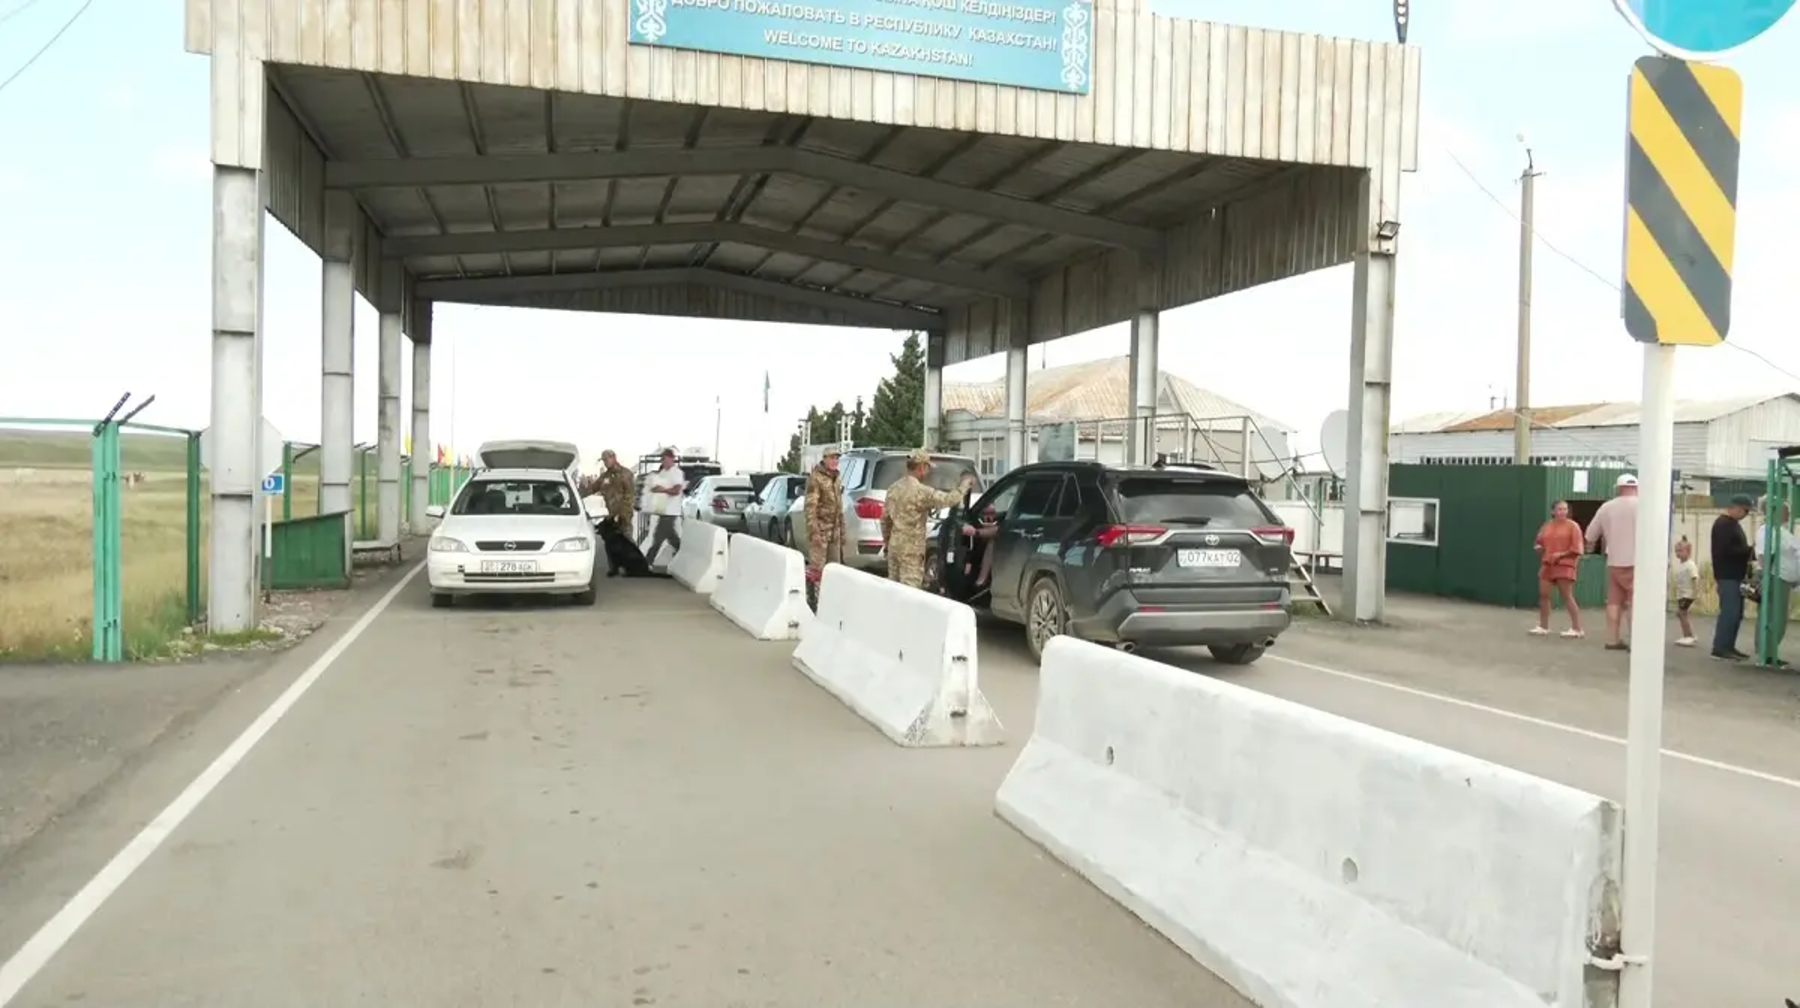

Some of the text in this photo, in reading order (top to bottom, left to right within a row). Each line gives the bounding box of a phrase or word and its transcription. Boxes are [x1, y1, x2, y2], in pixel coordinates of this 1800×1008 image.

[734, 0, 846, 24] ПОЖАЛОВАТЬ
[849, 12, 860, 25] В
[864, 14, 962, 39] РЕСПУБЛИКУ
[968, 27, 1057, 51] КАЗАХСТАН!
[764, 28, 974, 67] WELCOME TO KAZAKHSTAN!
